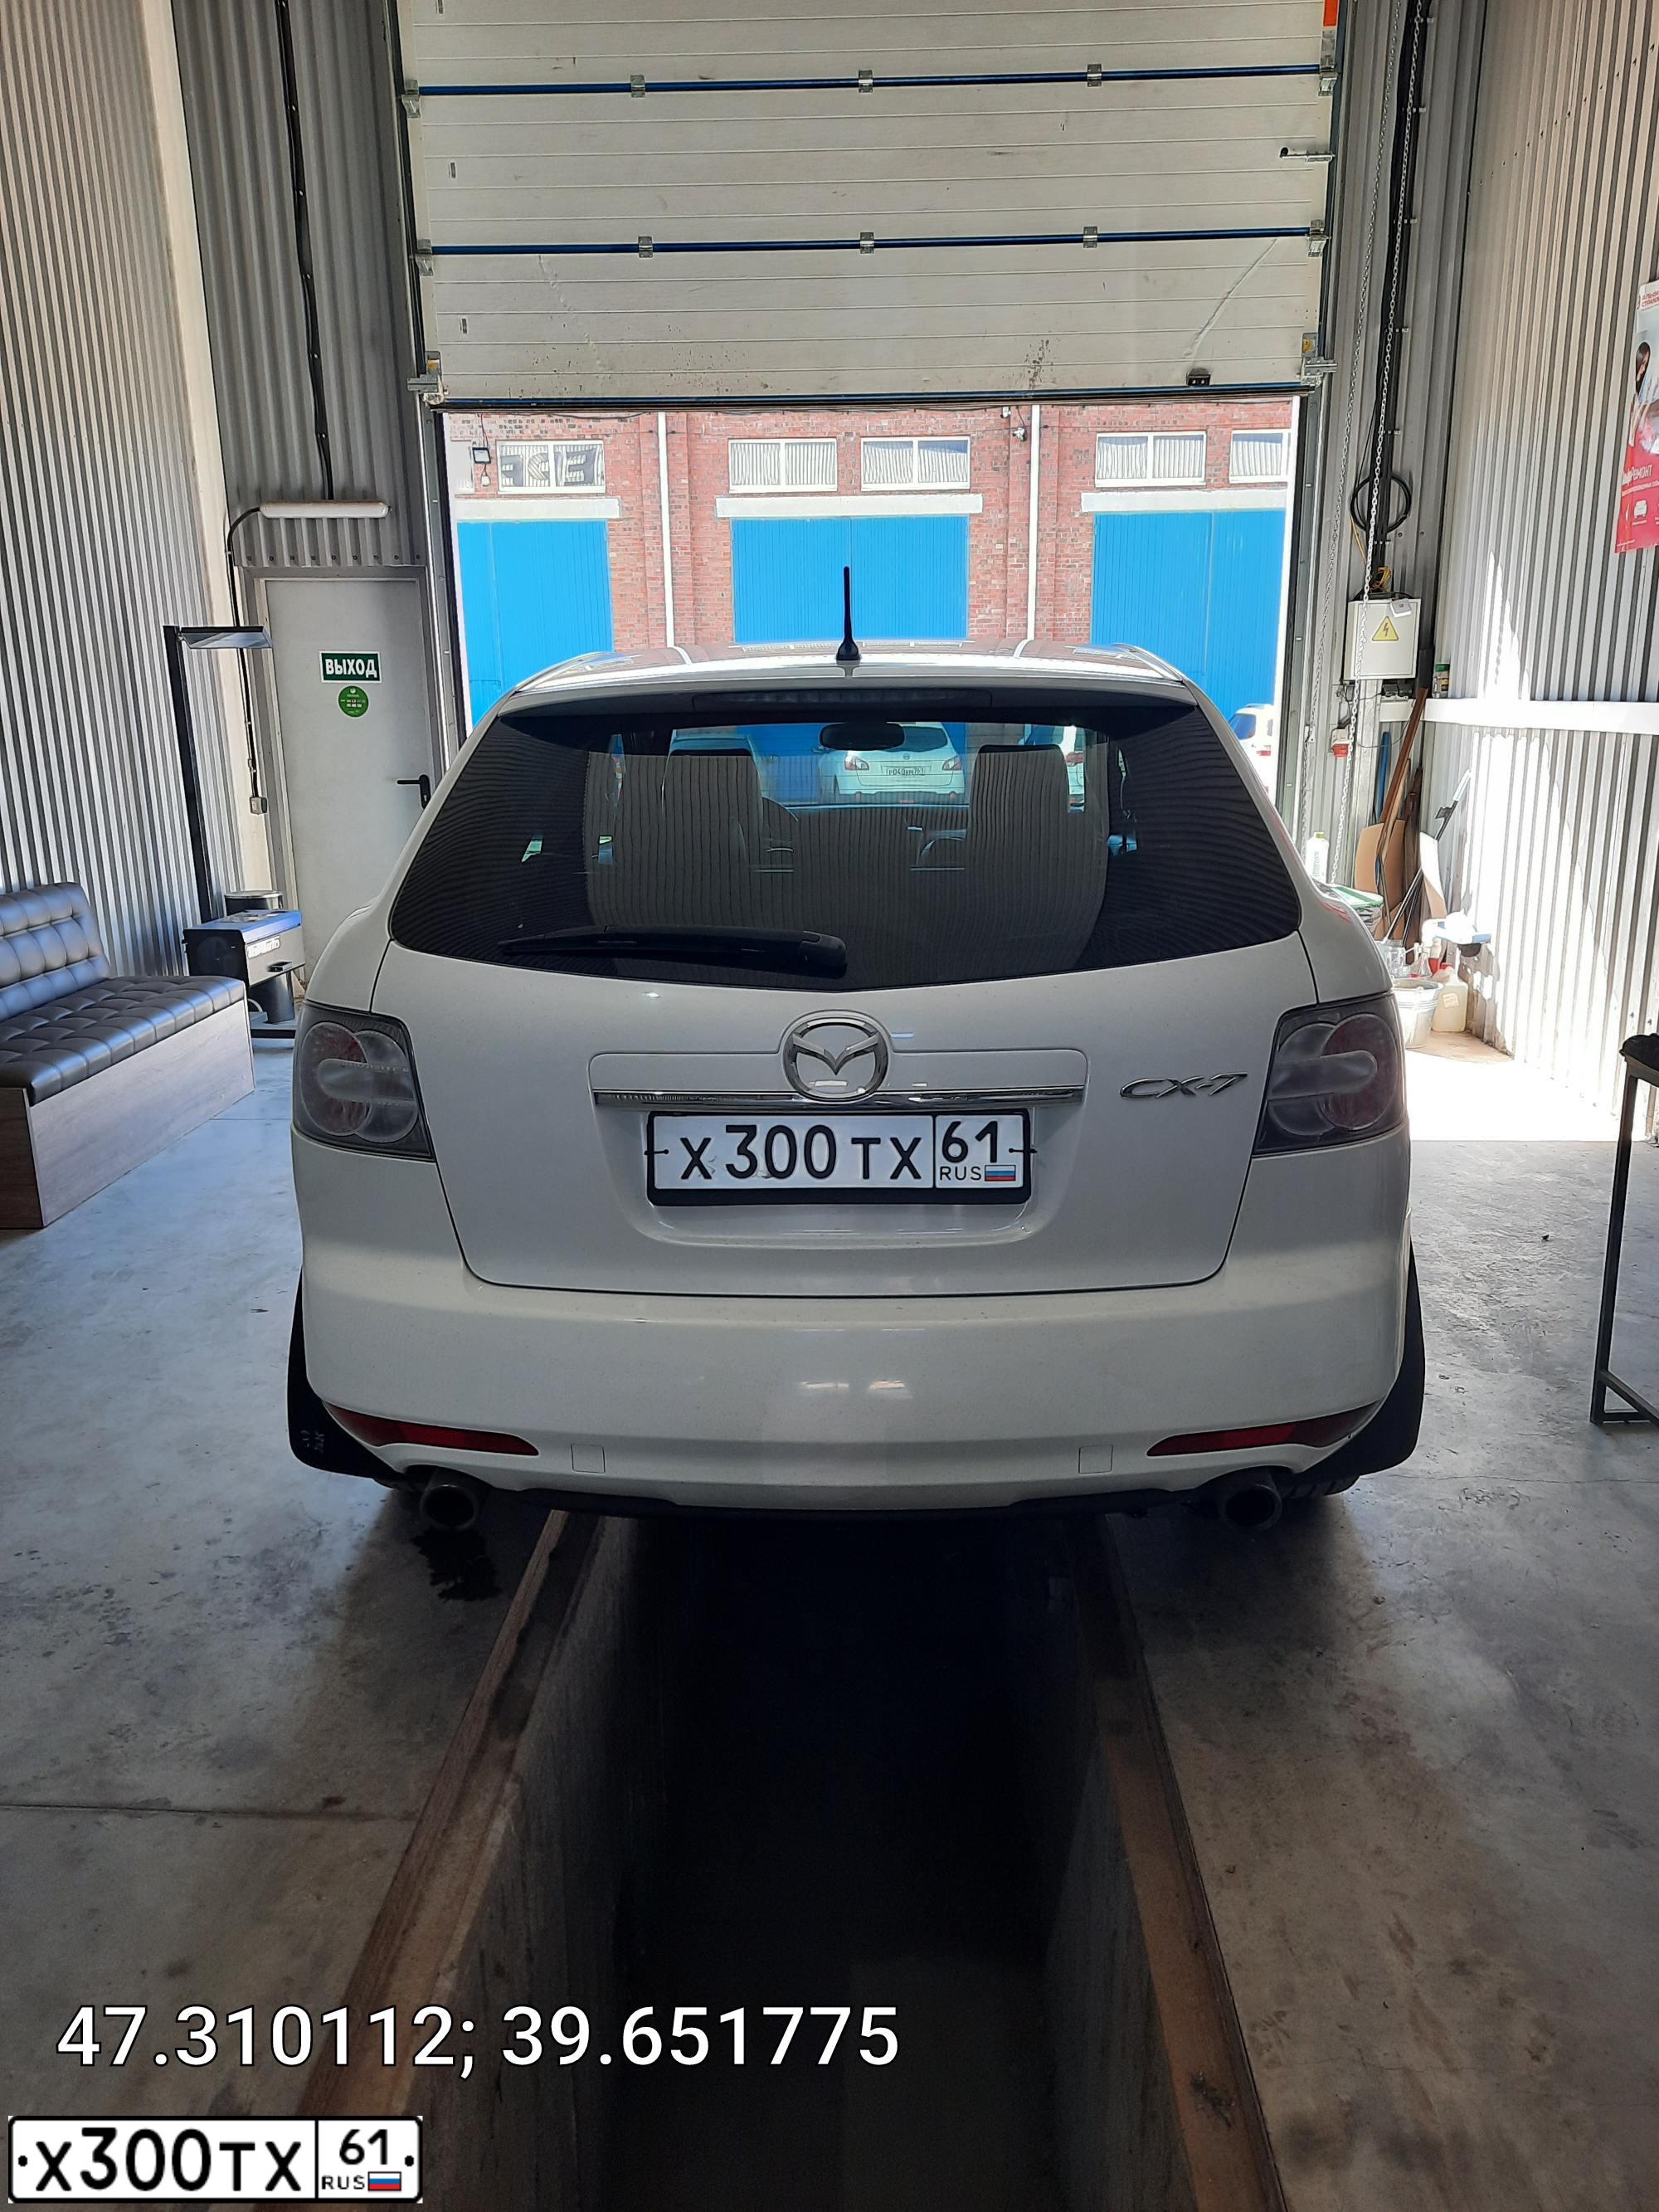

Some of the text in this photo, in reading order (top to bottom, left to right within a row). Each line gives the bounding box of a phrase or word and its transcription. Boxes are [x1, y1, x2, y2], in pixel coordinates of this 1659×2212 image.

[325, 658, 377, 679] ВЫХОД
[1120, 1072, 1248, 1099] CX-7
[941, 1120, 999, 1164] 61
[939, 1166, 982, 1182] RUS
